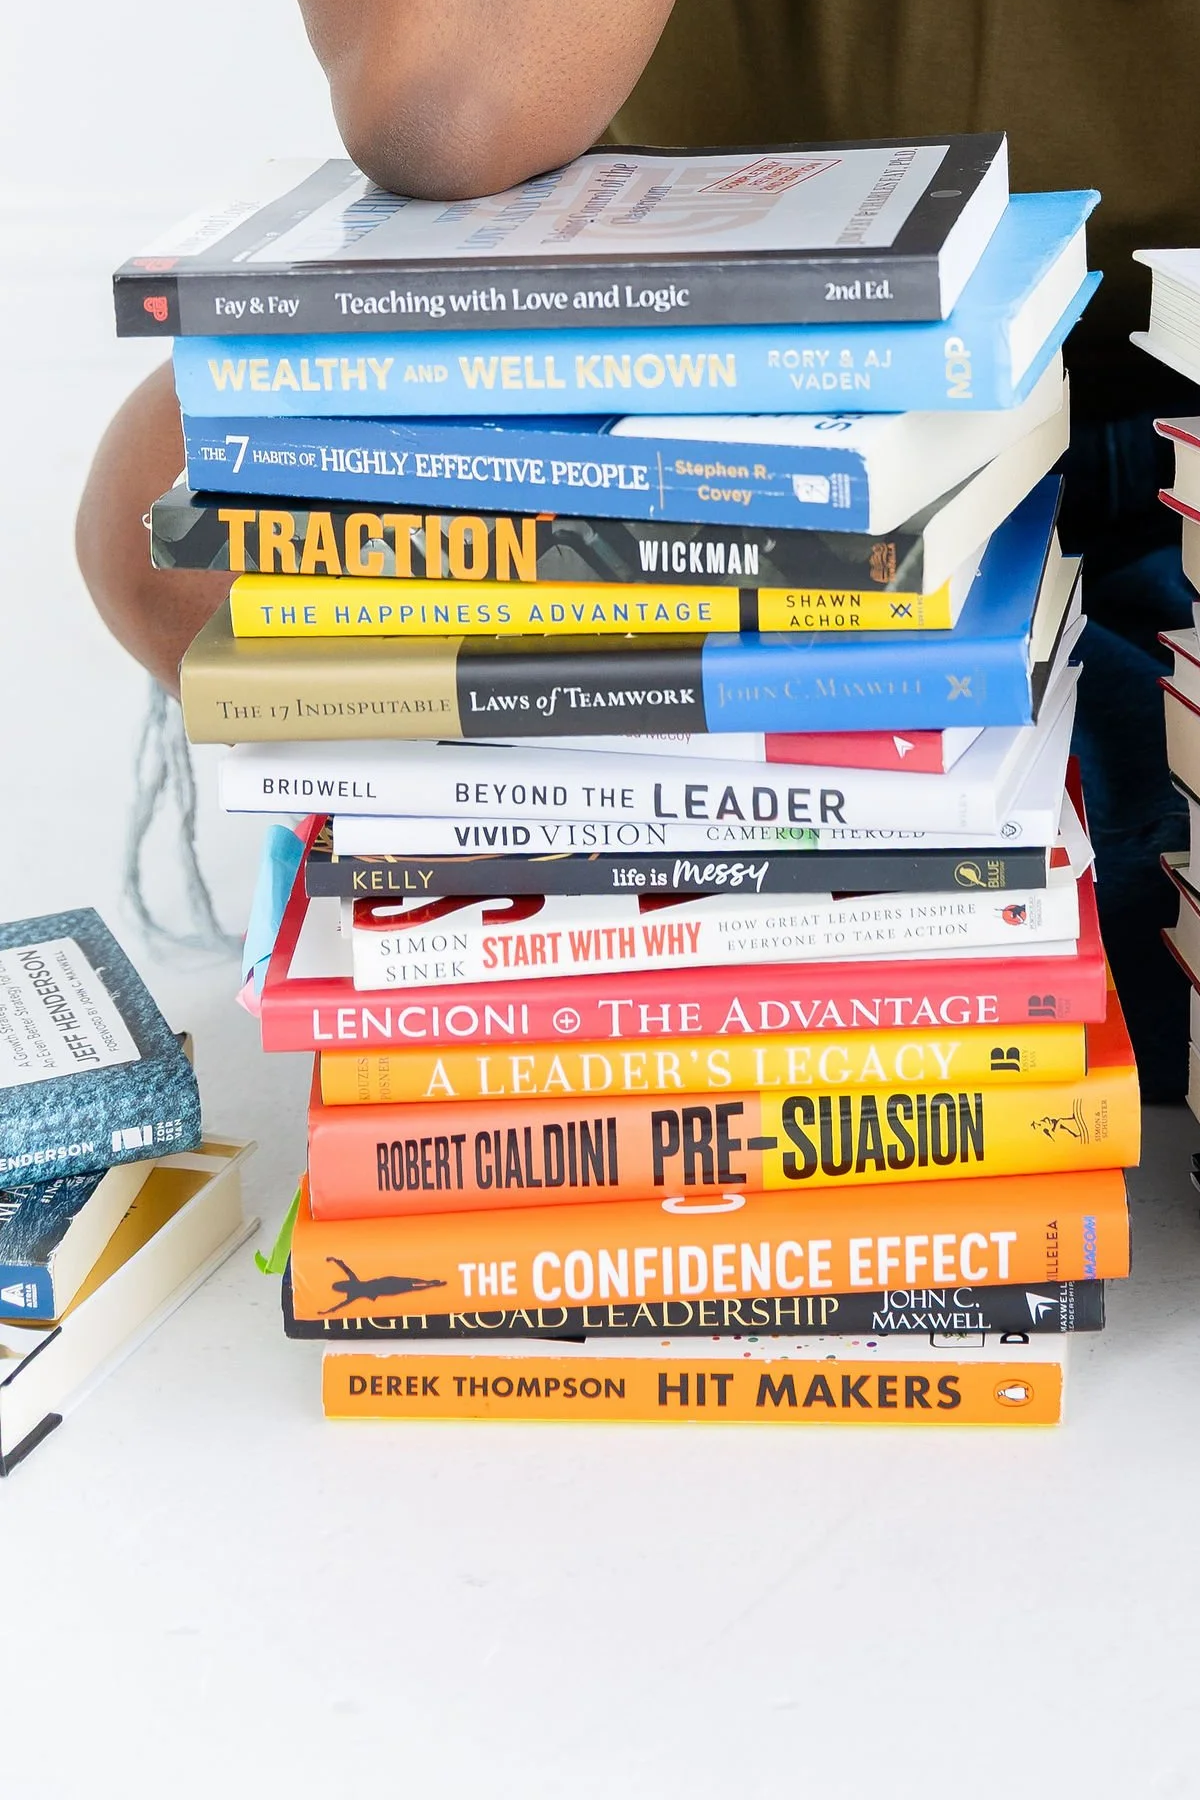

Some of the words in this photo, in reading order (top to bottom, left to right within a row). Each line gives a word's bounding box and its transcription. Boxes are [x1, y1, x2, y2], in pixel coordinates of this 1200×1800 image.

[215, 297, 244, 317] Fay
[250, 298, 264, 315] &
[268, 296, 300, 317] Fay
[334, 291, 446, 317] Teaching
[450, 288, 507, 312] with
[511, 287, 567, 311] Love
[572, 286, 620, 310] and
[625, 283, 689, 309] Logic
[825, 282, 861, 301] 2nd
[865, 281, 894, 300] Ed.
[208, 357, 395, 392] WEALTHY
[403, 364, 449, 383] AND
[458, 355, 566, 389] WELL
[576, 353, 738, 389] KNOWN
[840, 351, 853, 368] &
[791, 372, 871, 391] VADEN
[201, 446, 226, 462] THE
[253, 449, 297, 466] HABITS
[320, 447, 407, 476] HIGHLY
[415, 453, 545, 485] EFFECTIVE
[551, 463, 649, 490] PEOPLE
[218, 508, 537, 582] TRACTION
[639, 539, 760, 576] WICKMAN
[261, 605, 316, 625] THE
[336, 604, 511, 624] HAPPINESS
[529, 602, 712, 622] ADVANTAGE
[786, 594, 861, 609] SHAWN
[790, 614, 861, 627] ACHOR
[263, 778, 377, 799] BRIDWELL
[456, 783, 567, 806] BEYOND
[582, 788, 635, 809] THE
[653, 783, 847, 824] LEADER
[455, 825, 530, 847] VIVID
[707, 826, 820, 840] CAMERON
[353, 871, 434, 889] KELLY
[612, 868, 647, 887] life
[988, 860, 1000, 888] BLUE
[718, 918, 760, 933] HOW
[766, 914, 820, 930] GREAT
[910, 903, 976, 919] INSPIRE
[380, 934, 468, 956] SIMON
[482, 931, 562, 969] START
[569, 927, 635, 962] WITH
[642, 922, 701, 957] WHY
[727, 934, 816, 951] EVERYONE
[823, 932, 846, 943] TO
[853, 928, 896, 941] TAKE
[904, 923, 969, 939] ACTION
[386, 961, 466, 983] SINEK
[17, 950, 81, 1031] HENDERSON
[312, 1005, 529, 1040] LENCIONI
[63, 1034, 100, 1062] JEFF
[357, 1057, 370, 1100] KOUZES
[380, 1056, 390, 1100] POSNER
[756, 1042, 962, 1085] LEGACY
[377, 1134, 466, 1192] ROBERT
[475, 1117, 618, 1190] CIALDINI
[651, 1091, 984, 1186] PRE-SUASION
[458, 1262, 517, 1298] THE
[532, 1238, 832, 1301] CONFIDENCE
[849, 1232, 1016, 1284] EFFECT
[349, 1375, 440, 1397] DEREK
[453, 1376, 625, 1398] THOMPSON
[658, 1372, 734, 1406] HIT
[756, 1374, 961, 1408] MAKERS
